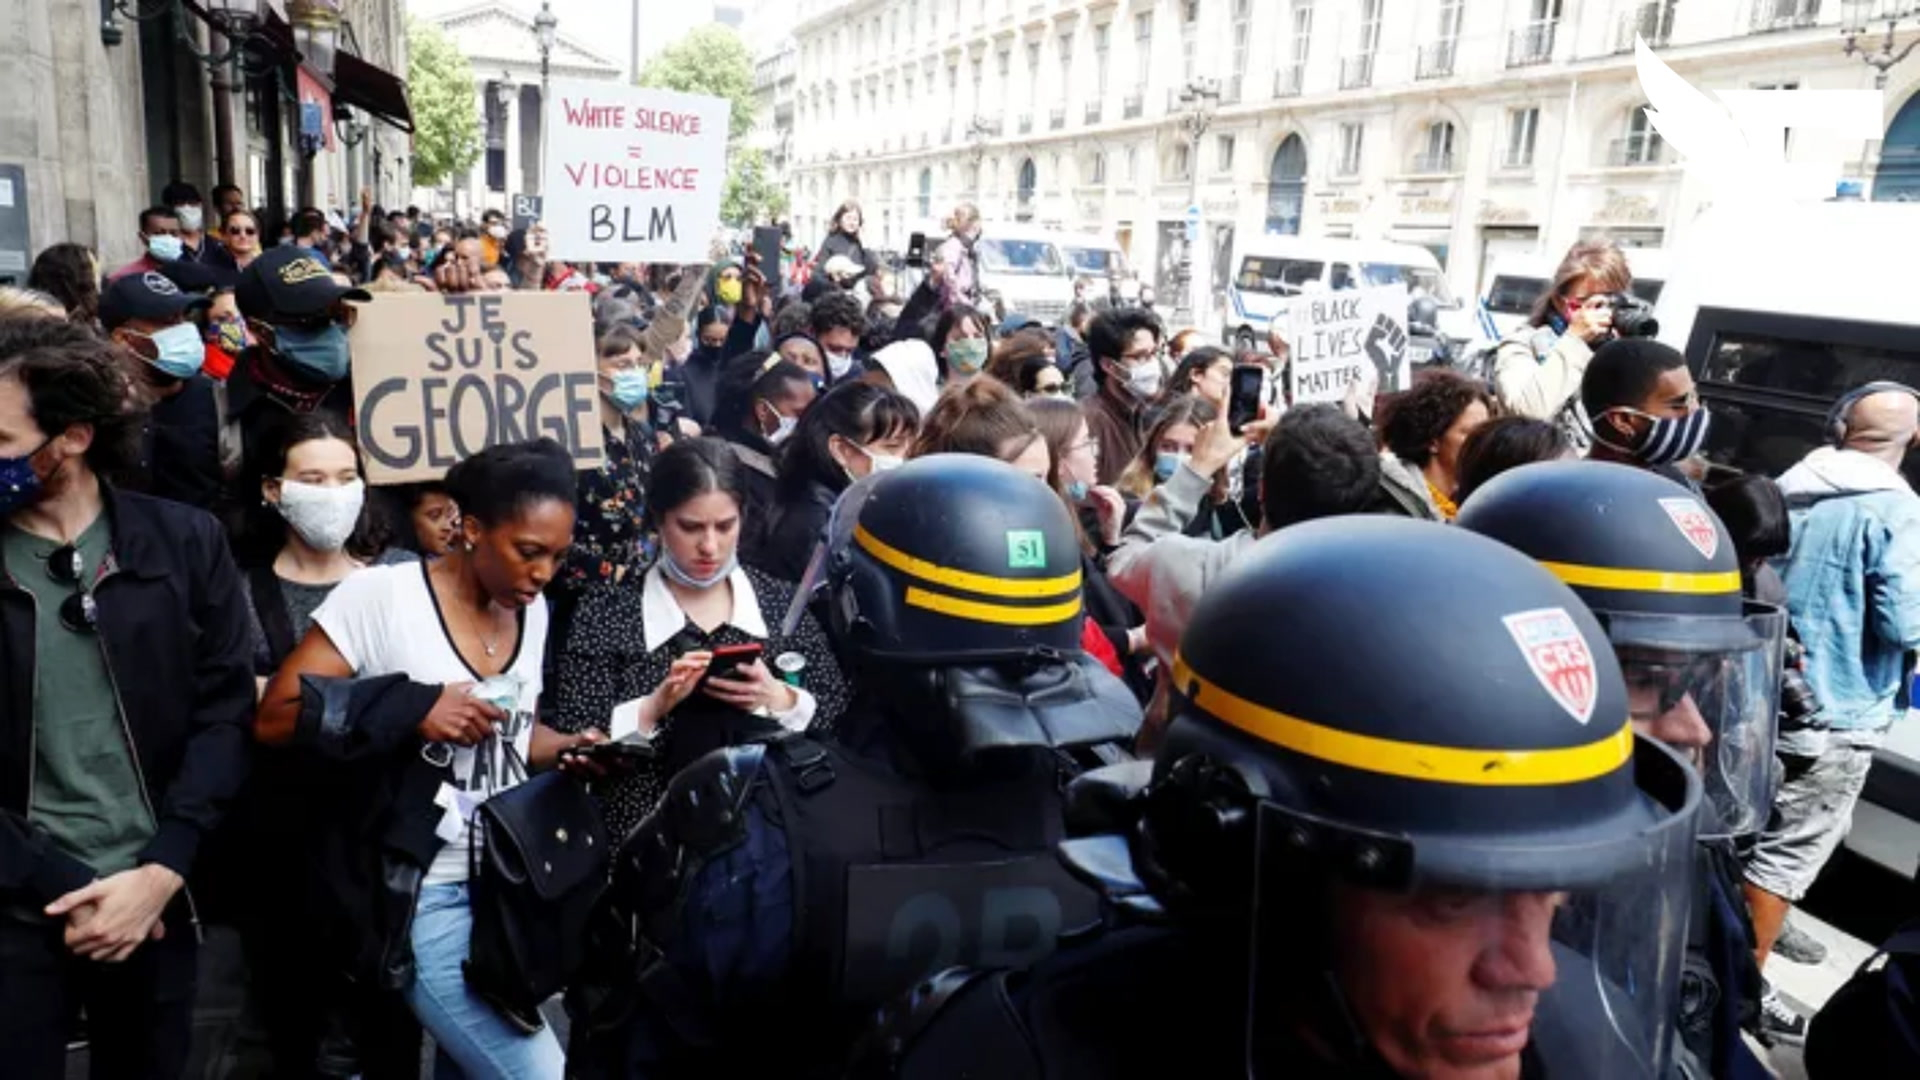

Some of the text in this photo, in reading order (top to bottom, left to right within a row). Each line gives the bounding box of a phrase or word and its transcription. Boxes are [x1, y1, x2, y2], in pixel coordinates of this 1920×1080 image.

[562, 98, 700, 136] WHITE SILENCE
[565, 162, 699, 190] VIOLENCE
[590, 204, 678, 242] BLM
[441, 296, 505, 333] JE
[1297, 327, 1362, 362] LIVES
[1297, 365, 1362, 396] MATTER
[359, 373, 603, 469] GEORGE
[1534, 640, 1590, 673] CRS
